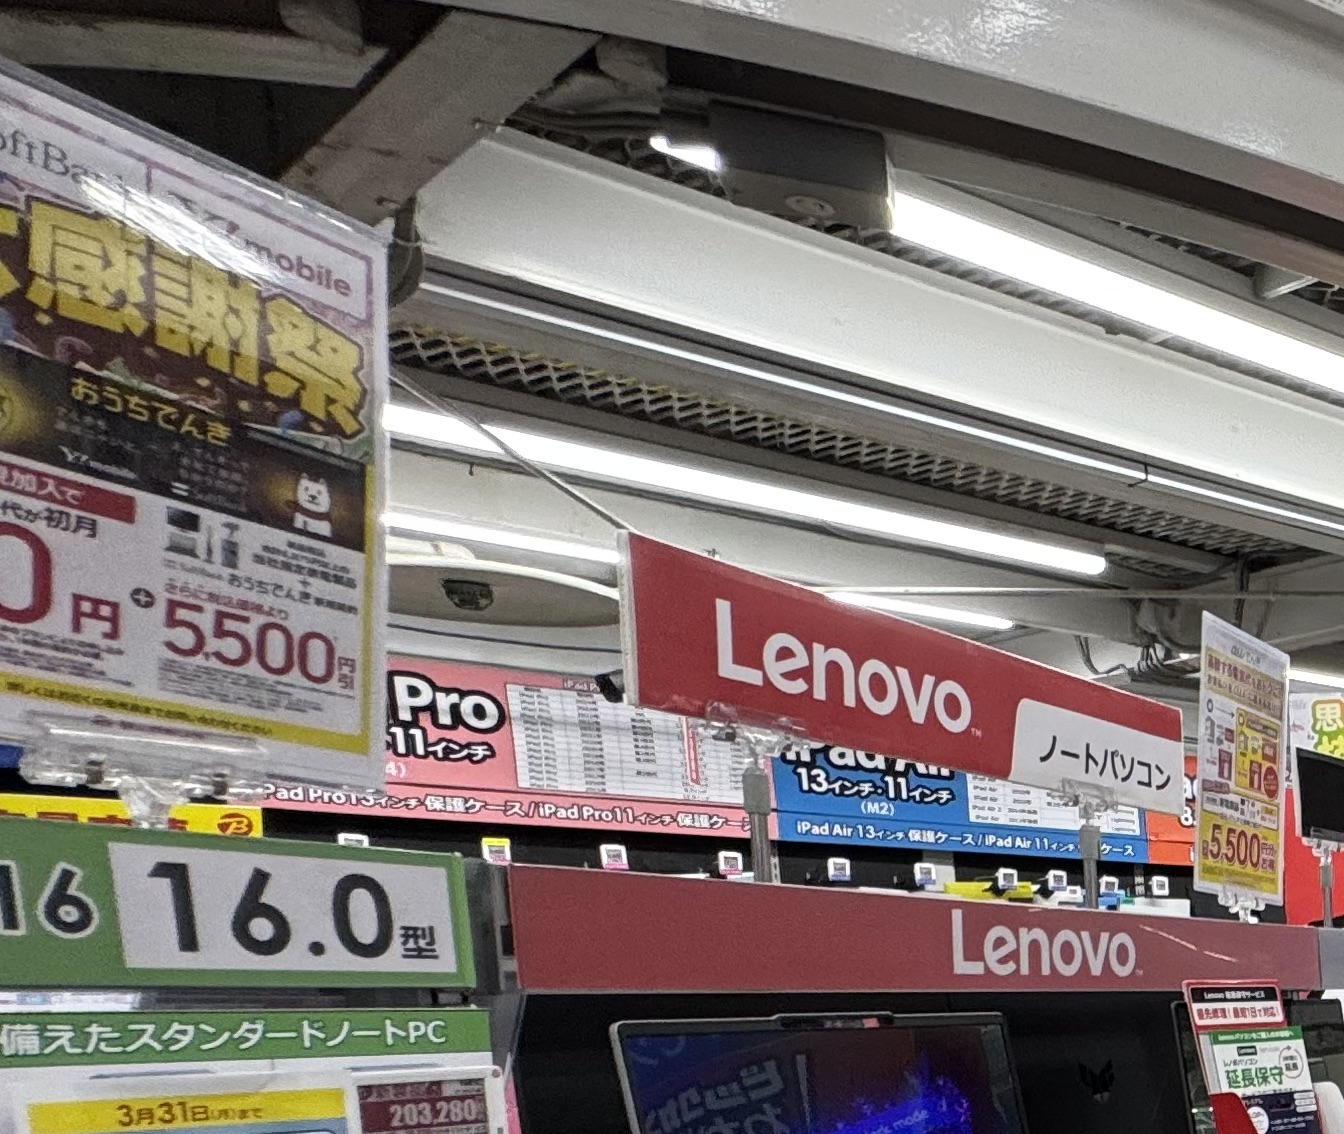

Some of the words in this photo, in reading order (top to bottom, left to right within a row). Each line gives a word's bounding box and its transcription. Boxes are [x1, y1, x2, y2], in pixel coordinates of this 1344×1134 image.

[68, 375, 232, 447] おうちでんき
[714, 597, 973, 735] Lenovo
[391, 674, 499, 733] Pro
[1038, 733, 1172, 792] ノートパソコン
[796, 820, 830, 838] iPad
[1013, 835, 1032, 851] Air
[860, 801, 895, 818] (M2)
[950, 908, 1137, 978] Lenovo
[1224, 1065, 1286, 1091] 延長保守
[892, 1107, 930, 1132] mode
